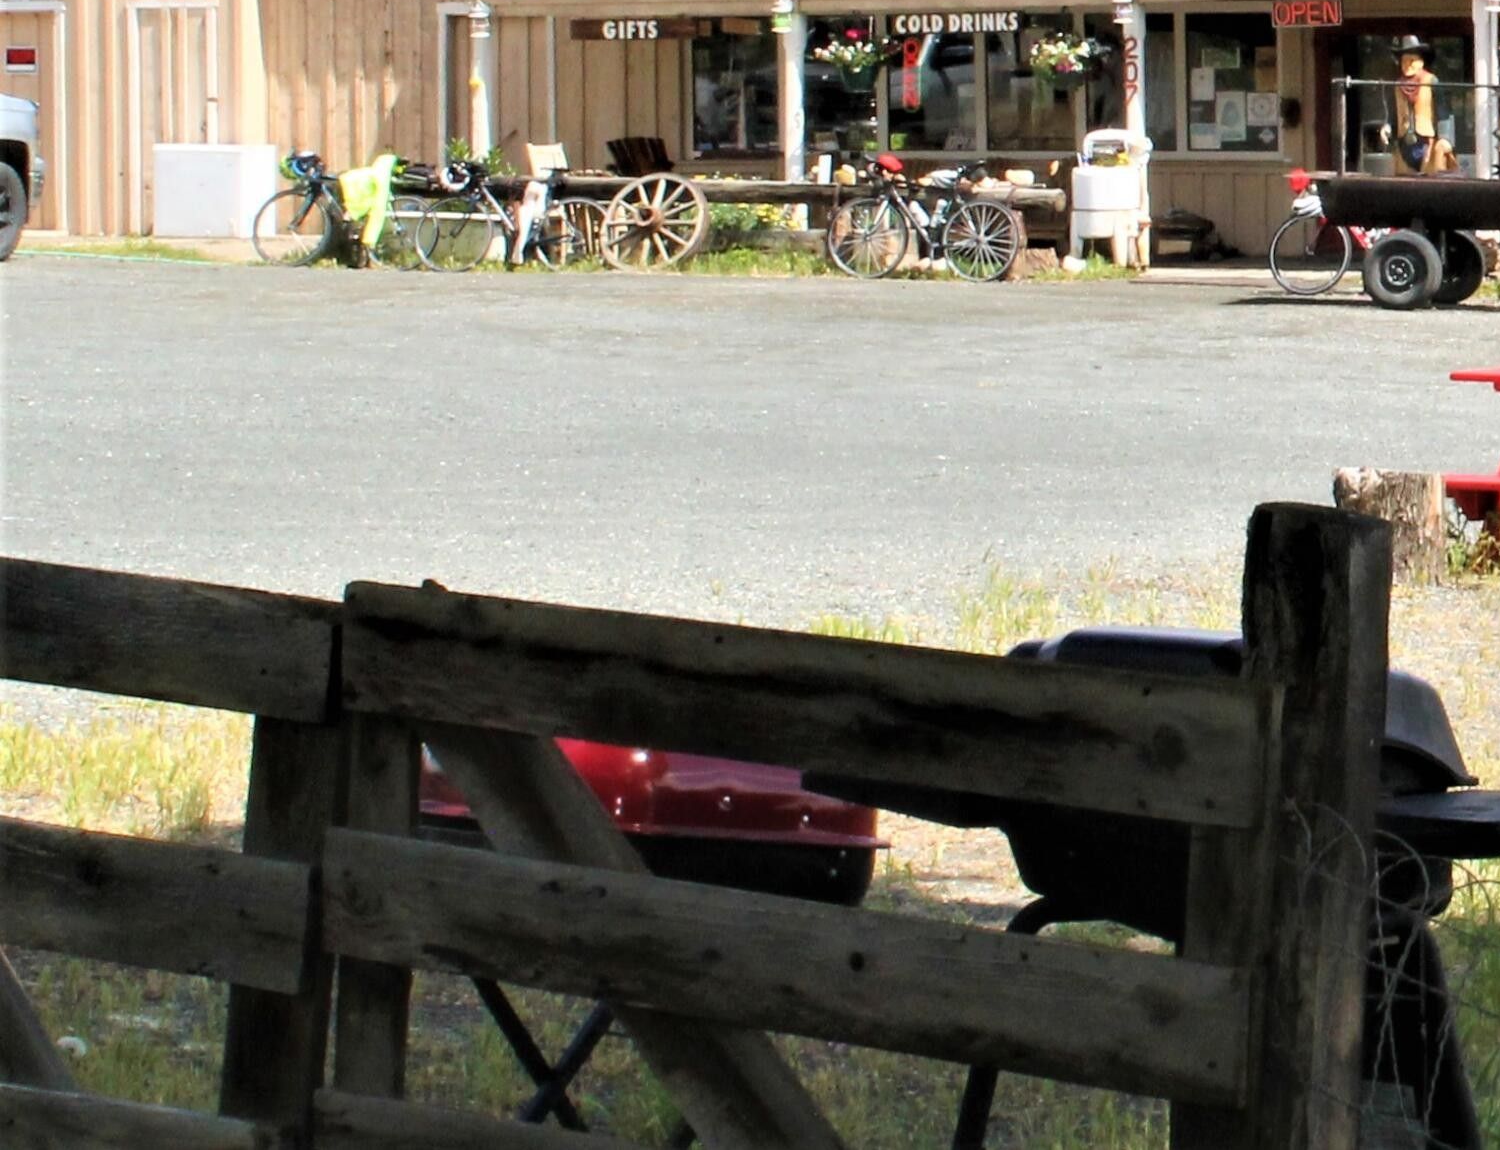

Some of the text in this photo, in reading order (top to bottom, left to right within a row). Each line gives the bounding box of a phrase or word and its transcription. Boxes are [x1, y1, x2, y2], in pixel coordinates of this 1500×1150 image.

[895, 11, 1019, 34] COLD DRINKS
[1274, 0, 1339, 26] OPEN
[602, 19, 659, 40] GIFTS
[1123, 36, 1138, 107] 207
